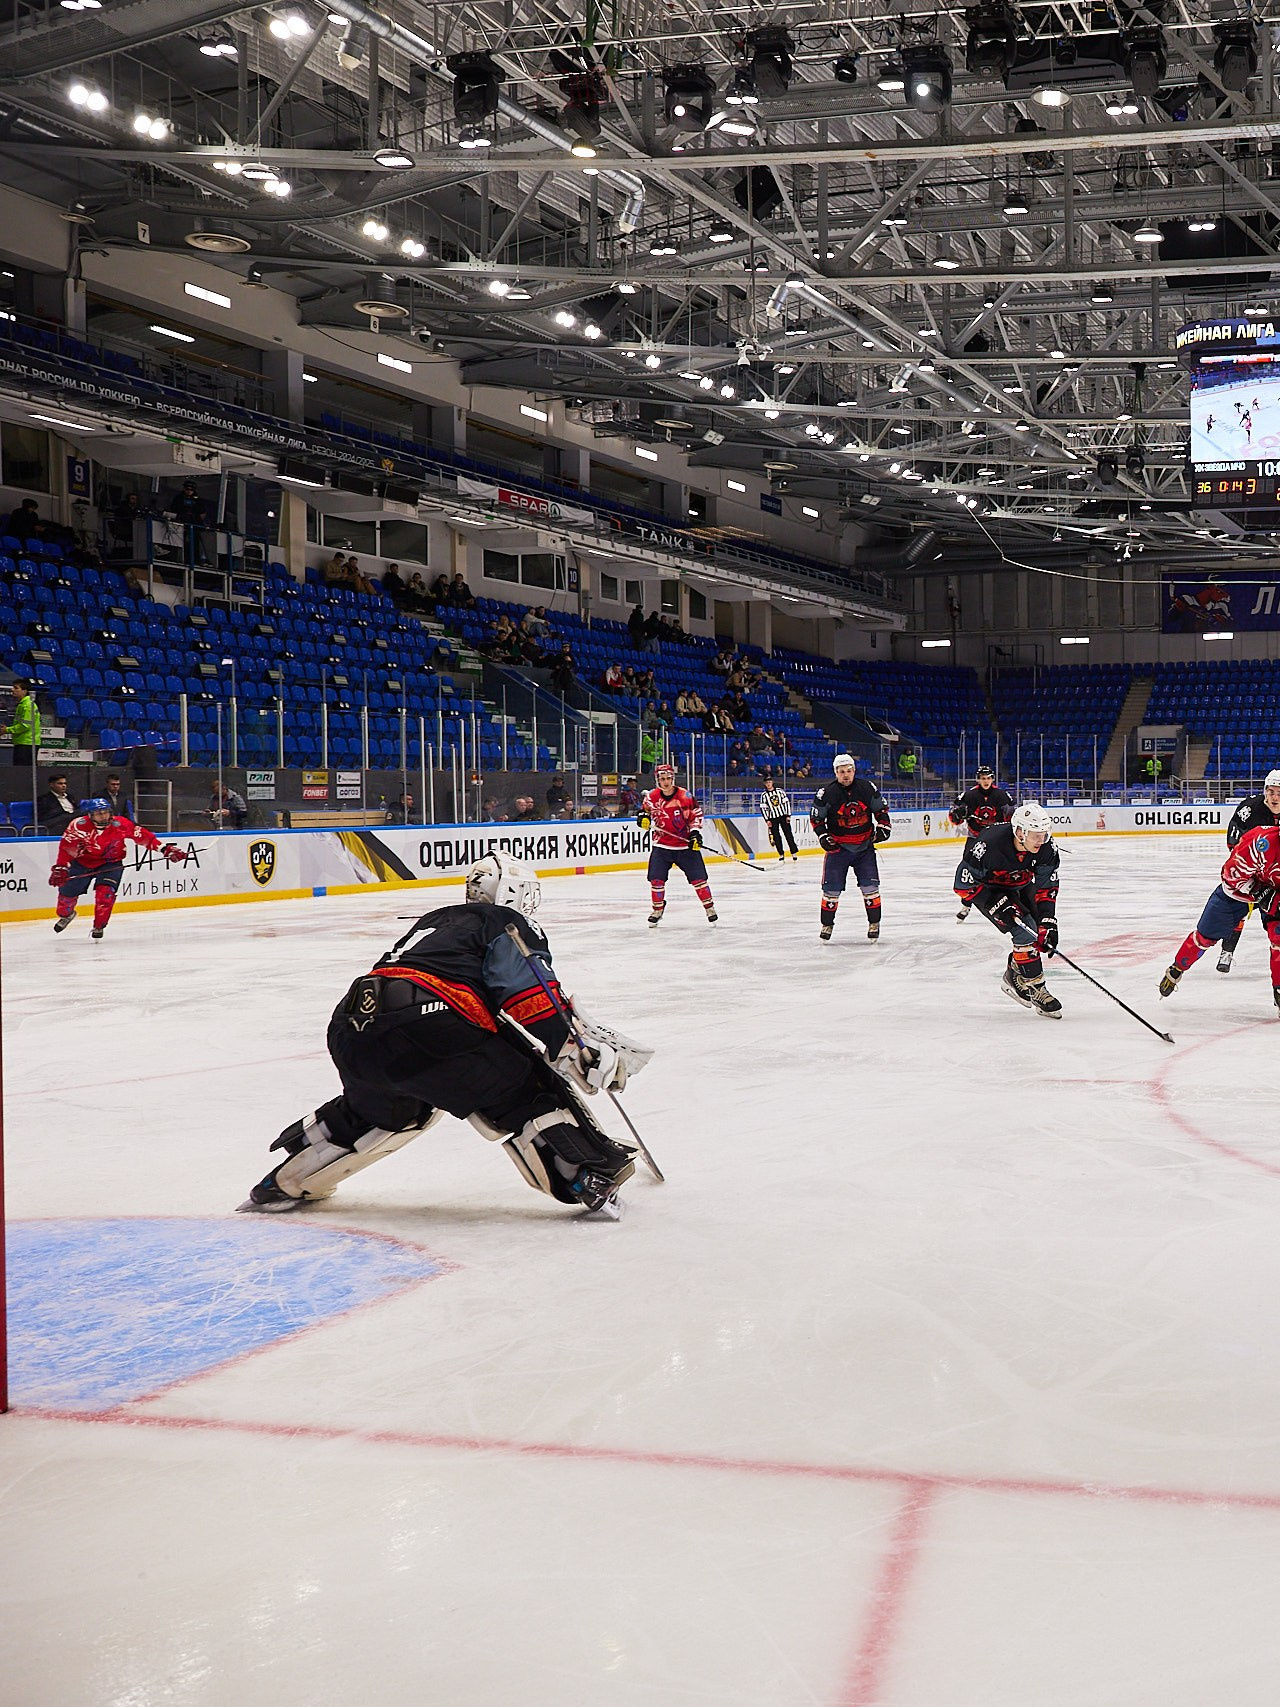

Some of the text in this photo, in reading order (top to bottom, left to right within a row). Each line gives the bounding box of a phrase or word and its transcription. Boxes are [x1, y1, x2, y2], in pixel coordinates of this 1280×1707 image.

[1236, 323, 1275, 339] ЛИГА
[32, 368, 77, 388] РОССИИ
[81, 381, 95, 394] ПО
[99, 387, 140, 406] ХОККЕЮ
[156, 402, 234, 431] ВСЕРОССИЙСКАЯ
[236, 423, 286, 443] ХОККЕЙНАЯ
[312, 444, 337, 459] СЕЗОН
[74, 464, 84, 482] 9
[1246, 479, 1256, 494] 3
[510, 495, 549, 513] SPAR
[636, 526, 684, 551] TANK
[570, 570, 577, 583] 10
[1050, 816, 1072, 824] РОСА
[1135, 811, 1221, 826] OHLIGA.RU
[420, 825, 650, 869] ОФИЦЕРСКАЯ ХОККЕЙНА
[135, 841, 200, 872] ИГА
[123, 878, 199, 897] ИЛЬНЫХ
